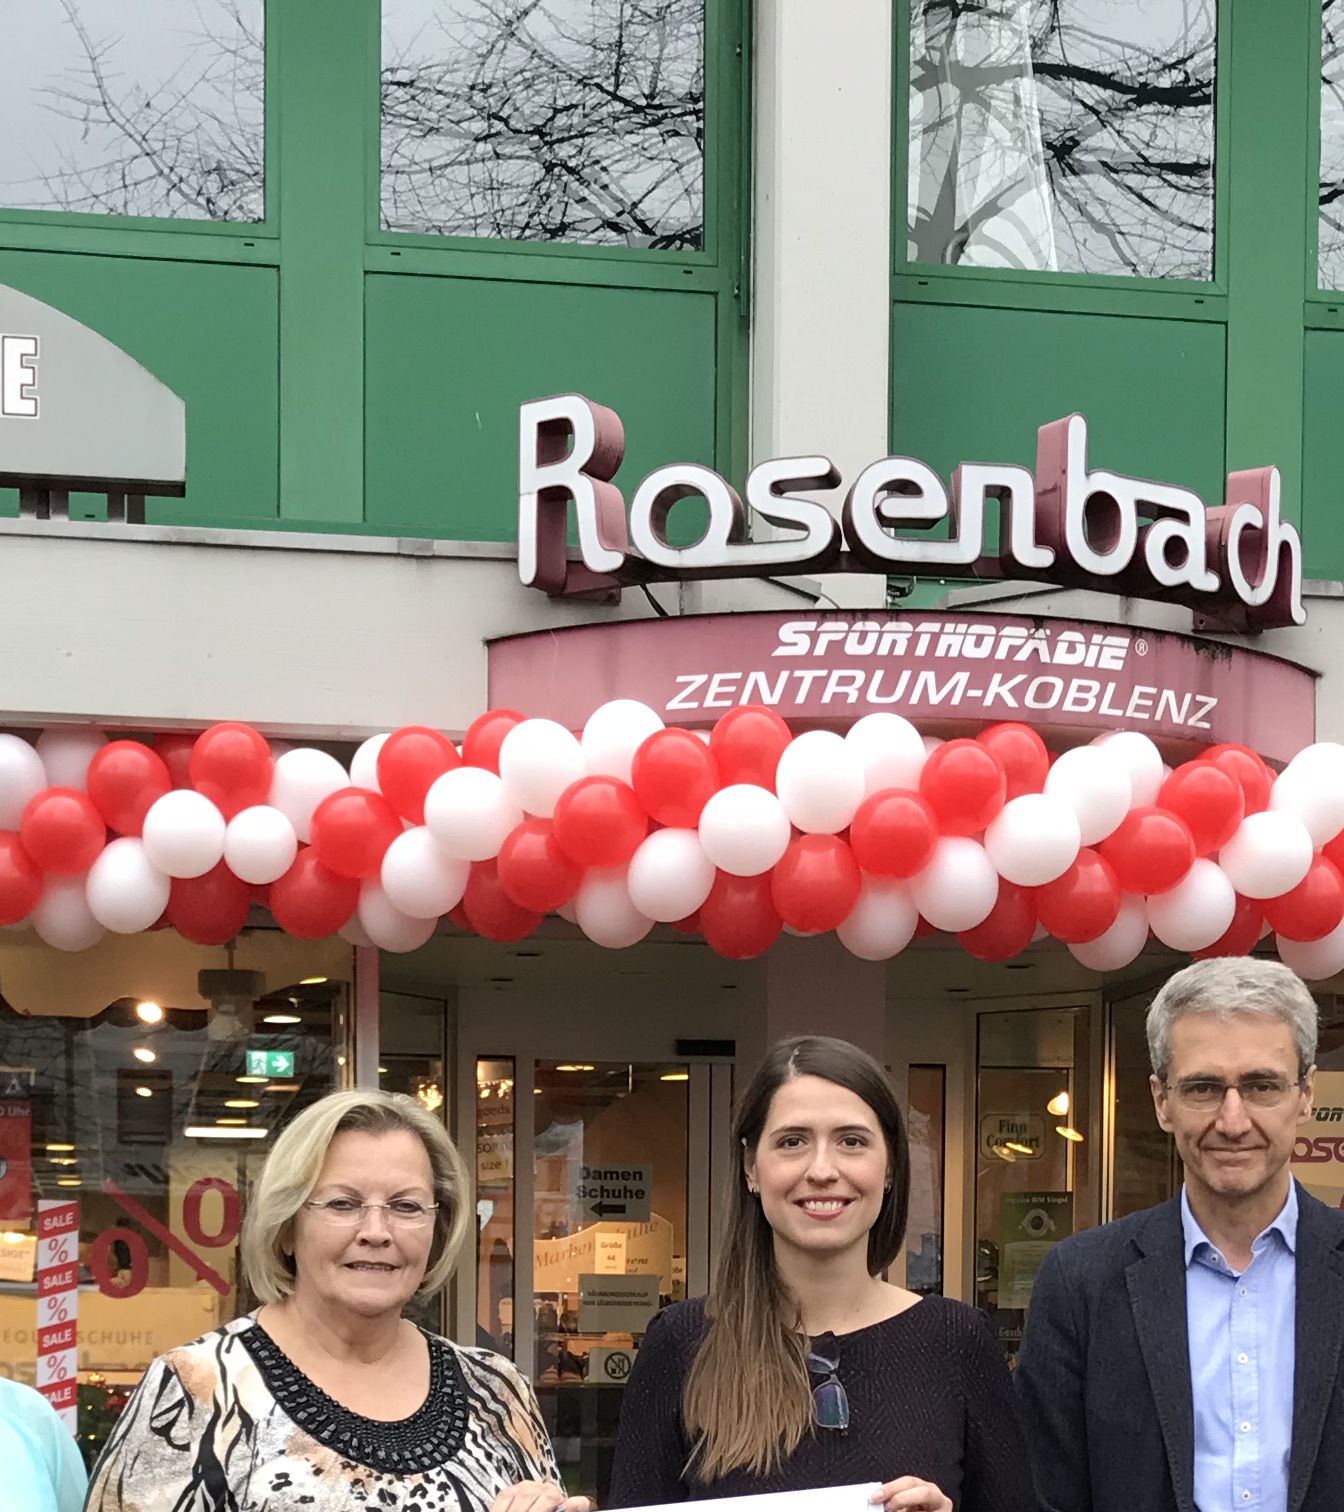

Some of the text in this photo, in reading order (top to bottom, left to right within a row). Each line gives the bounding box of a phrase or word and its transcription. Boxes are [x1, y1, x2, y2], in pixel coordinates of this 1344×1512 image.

[518, 393, 1308, 627] Rosenbach
[665, 669, 1219, 730] ZENTRUM-KOBLENZ
[998, 1118, 1028, 1135] Finn
[578, 1165, 644, 1182] Damen
[575, 1184, 646, 1200] Schuhe
[43, 1212, 74, 1231] SALE
[42, 1270, 74, 1289] SALE
[42, 1328, 73, 1348] SALE
